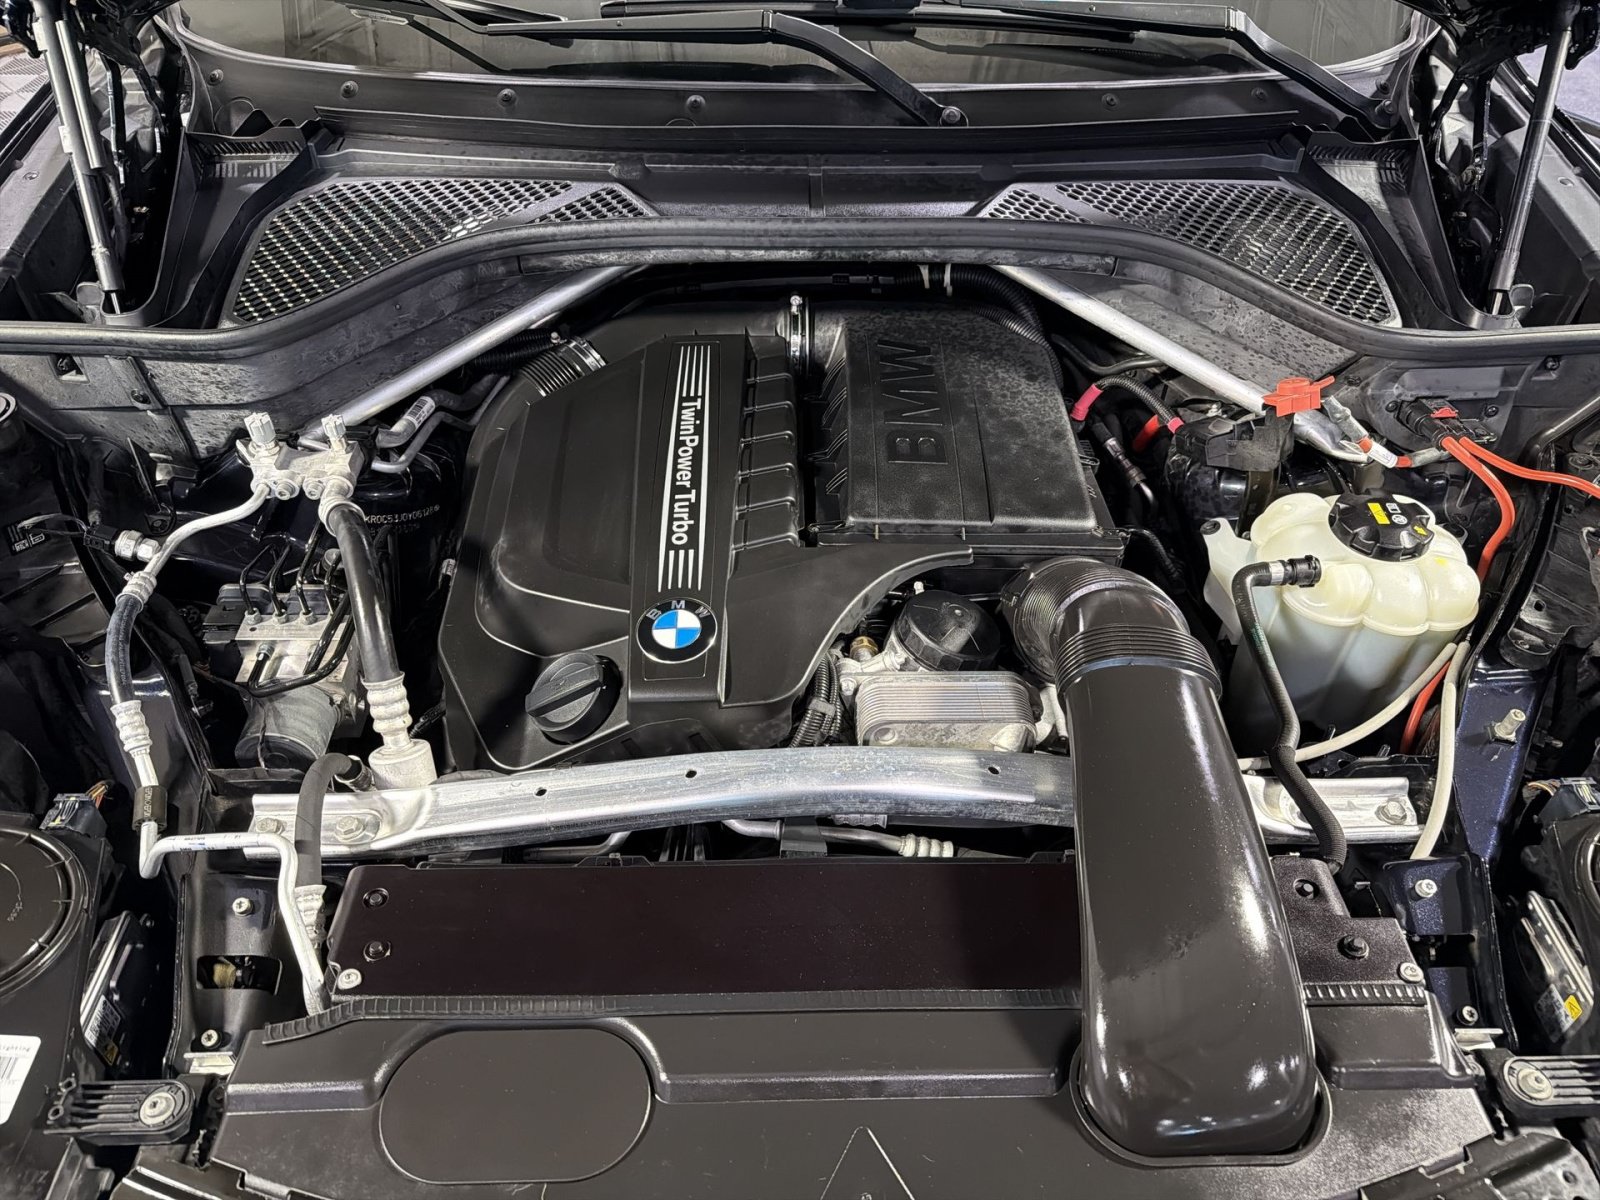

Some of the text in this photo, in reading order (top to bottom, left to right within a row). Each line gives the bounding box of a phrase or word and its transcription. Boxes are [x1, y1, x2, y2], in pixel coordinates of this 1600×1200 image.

[877, 340, 948, 465] BMW
[671, 398, 702, 545] TwinPower Turbo
[645, 600, 711, 620] BMW
